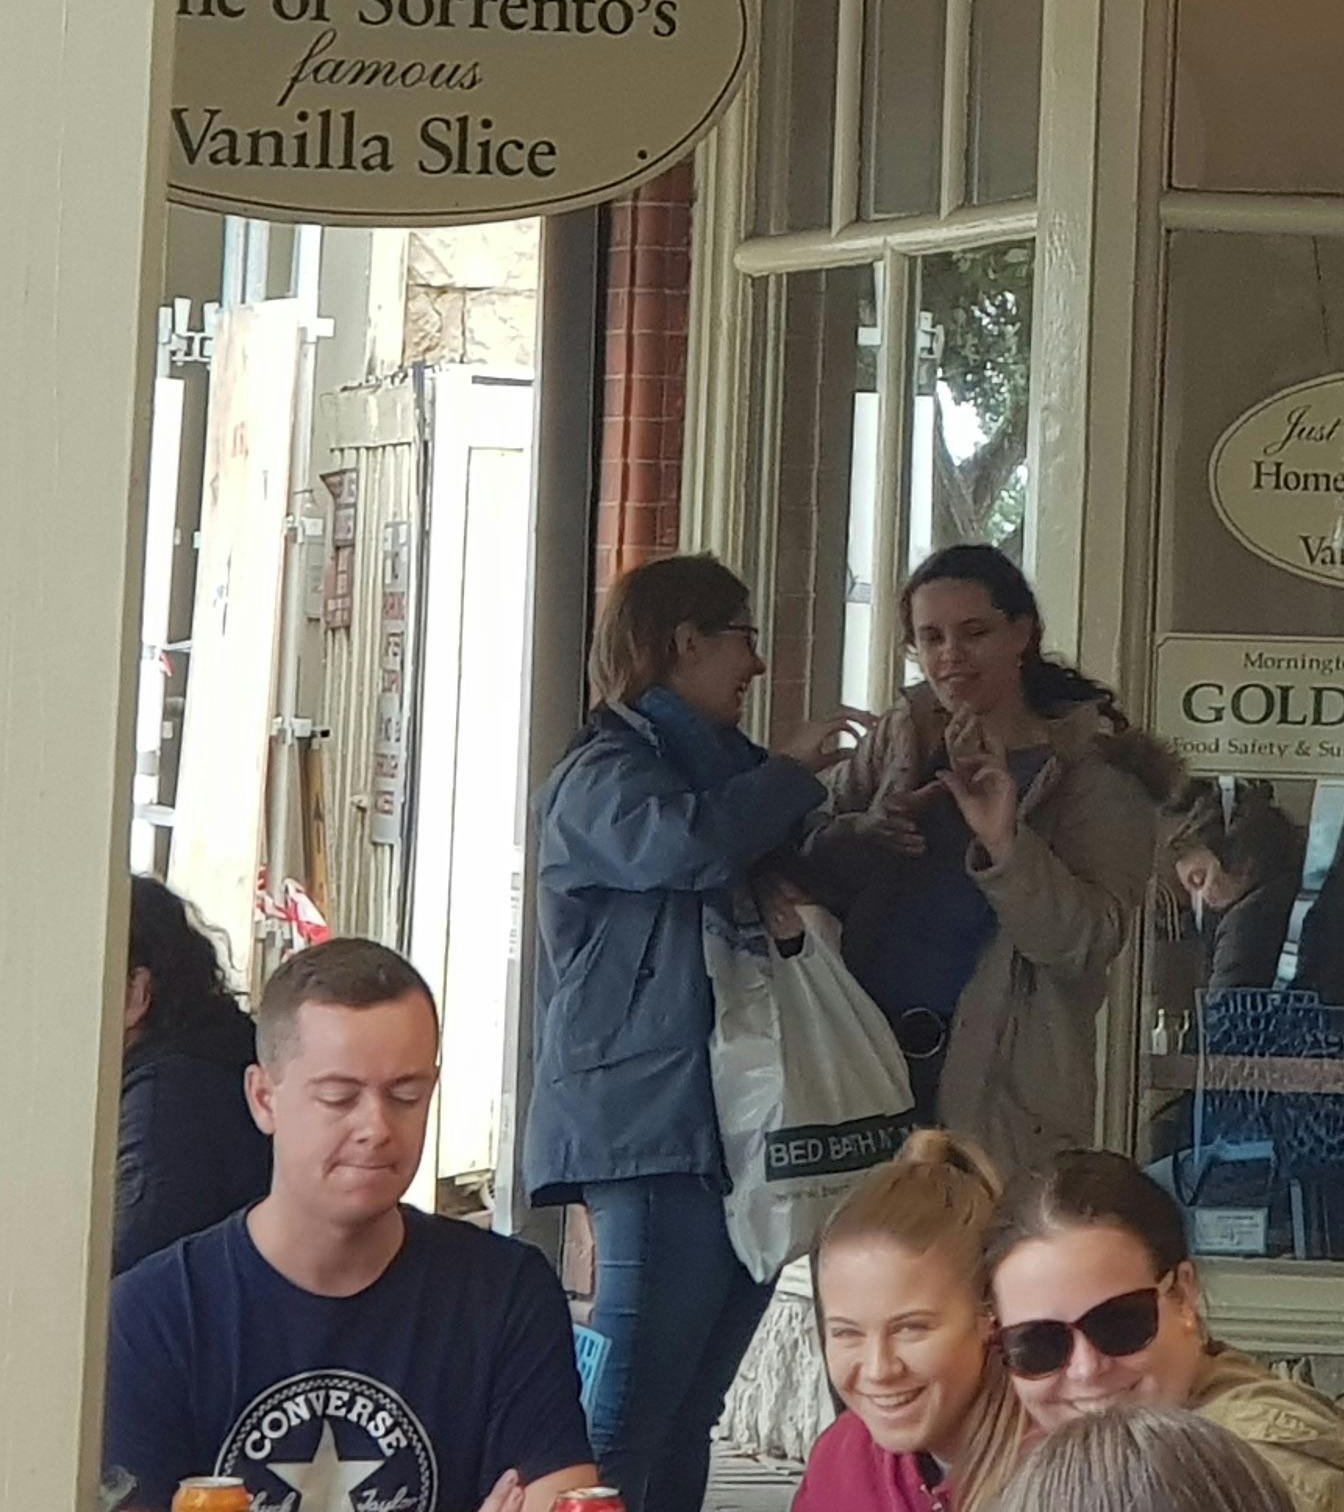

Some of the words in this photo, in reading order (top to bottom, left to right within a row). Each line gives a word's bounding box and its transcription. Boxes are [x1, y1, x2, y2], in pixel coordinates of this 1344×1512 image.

[276, 28, 484, 107] famous
[170, 107, 393, 174] Vanilla
[418, 116, 558, 178] Slice
[1264, 404, 1341, 457] Just
[1226, 738, 1289, 761] Safety
[1294, 740, 1312, 756] &
[769, 1139, 823, 1168] BED
[243, 1389, 408, 1461] CONVERSE
